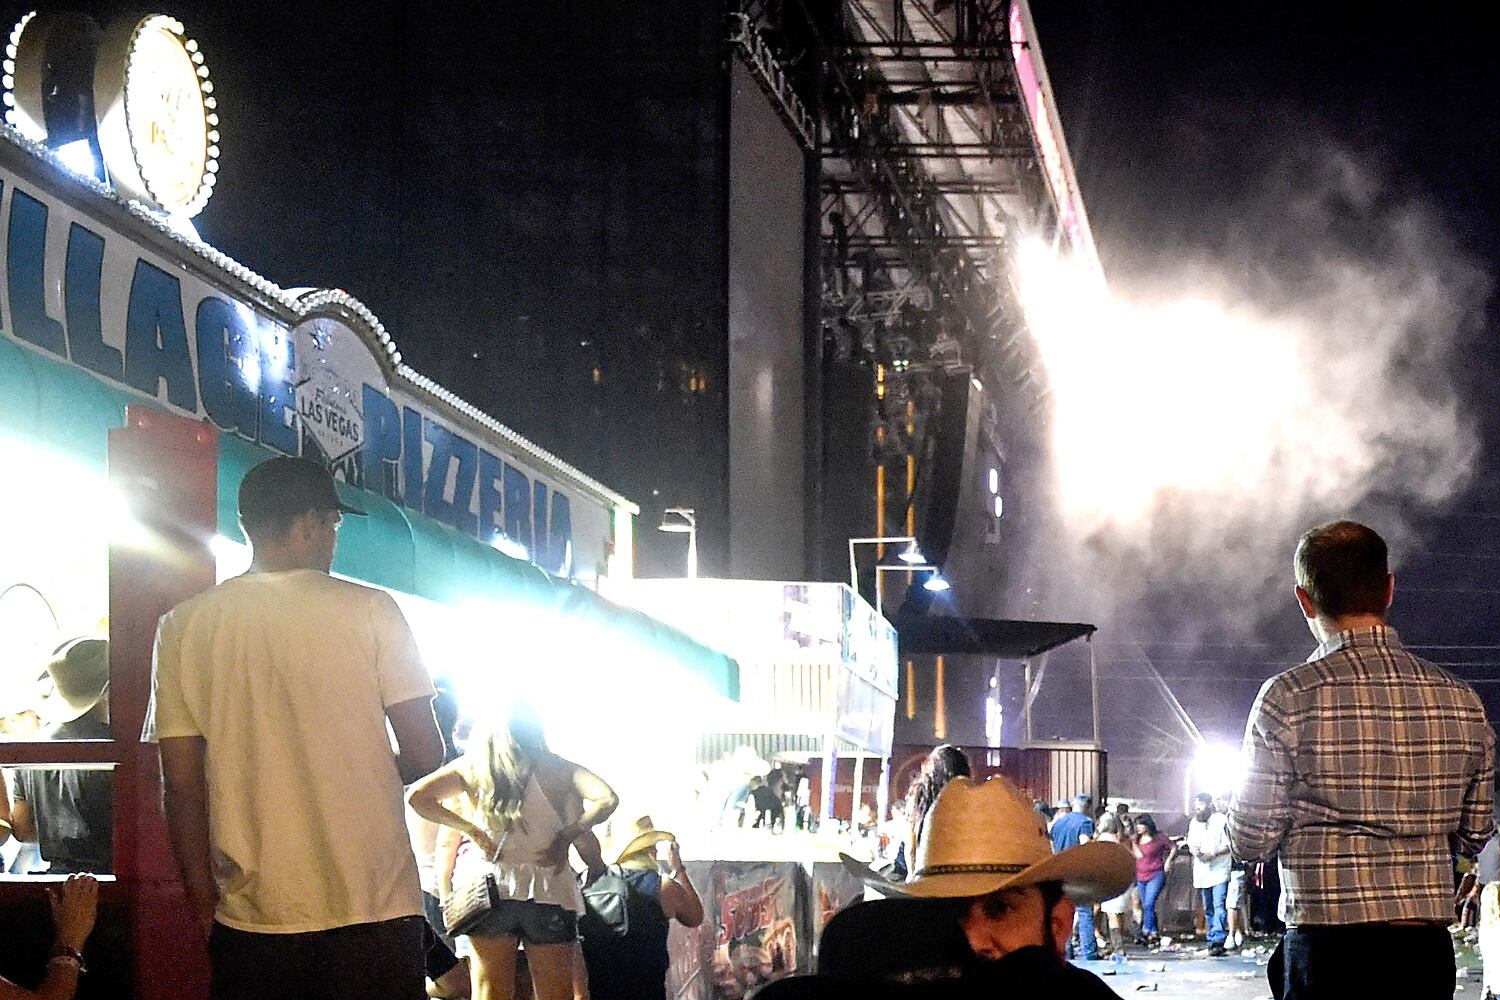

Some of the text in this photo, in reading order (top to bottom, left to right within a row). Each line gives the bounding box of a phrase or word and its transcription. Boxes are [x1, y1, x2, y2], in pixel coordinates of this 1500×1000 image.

[300, 396, 323, 424] LAS
[324, 407, 359, 442] VEGAS
[362, 382, 573, 580] PIZZERIA
